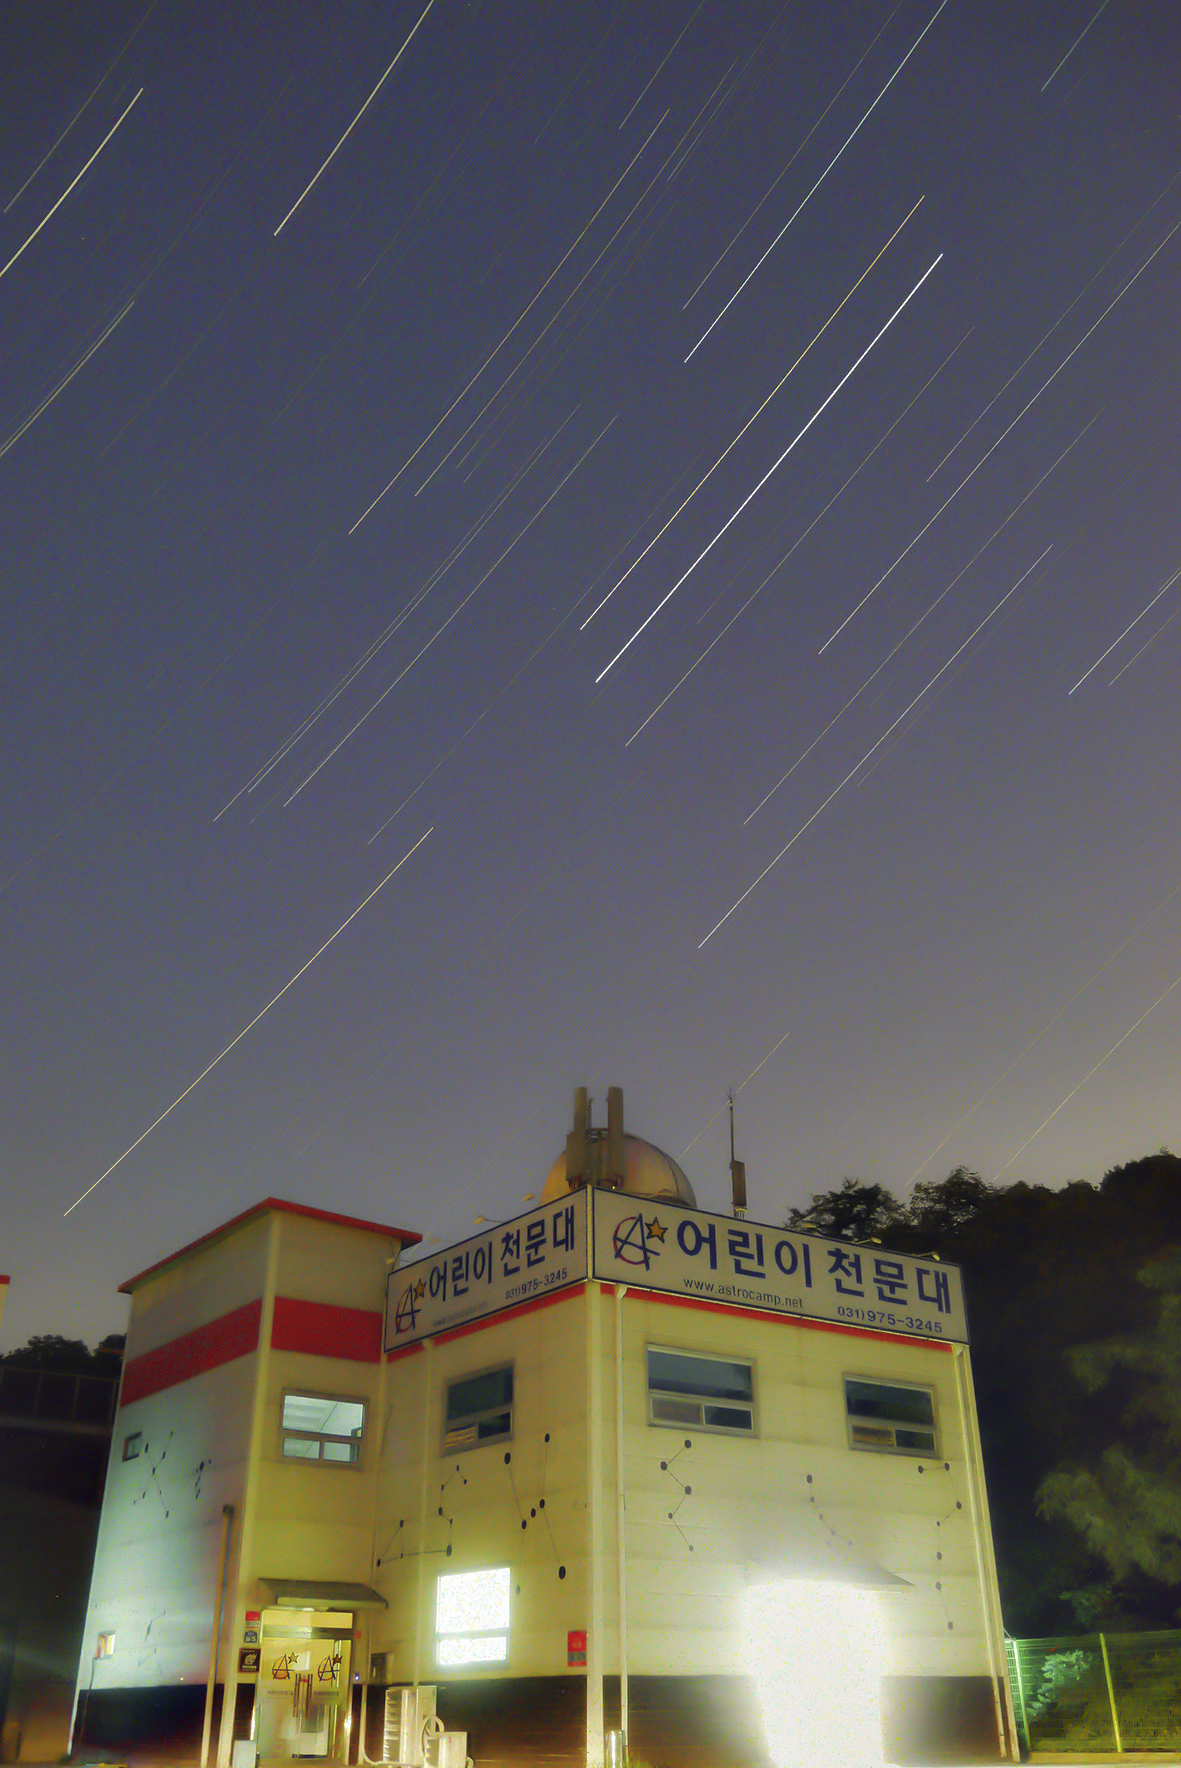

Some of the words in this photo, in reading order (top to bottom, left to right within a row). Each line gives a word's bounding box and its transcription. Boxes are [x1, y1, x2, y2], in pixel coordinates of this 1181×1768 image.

[429, 1241, 492, 1302] 어린이
[500, 1205, 575, 1277] 천문대
[676, 1220, 813, 1289] 어린이
[827, 1247, 951, 1314] 천문대
[505, 1267, 568, 1300] 031)975-3245
[683, 1277, 803, 1310] www.astrocamp.net
[837, 1305, 943, 1334] 031)975-3245
